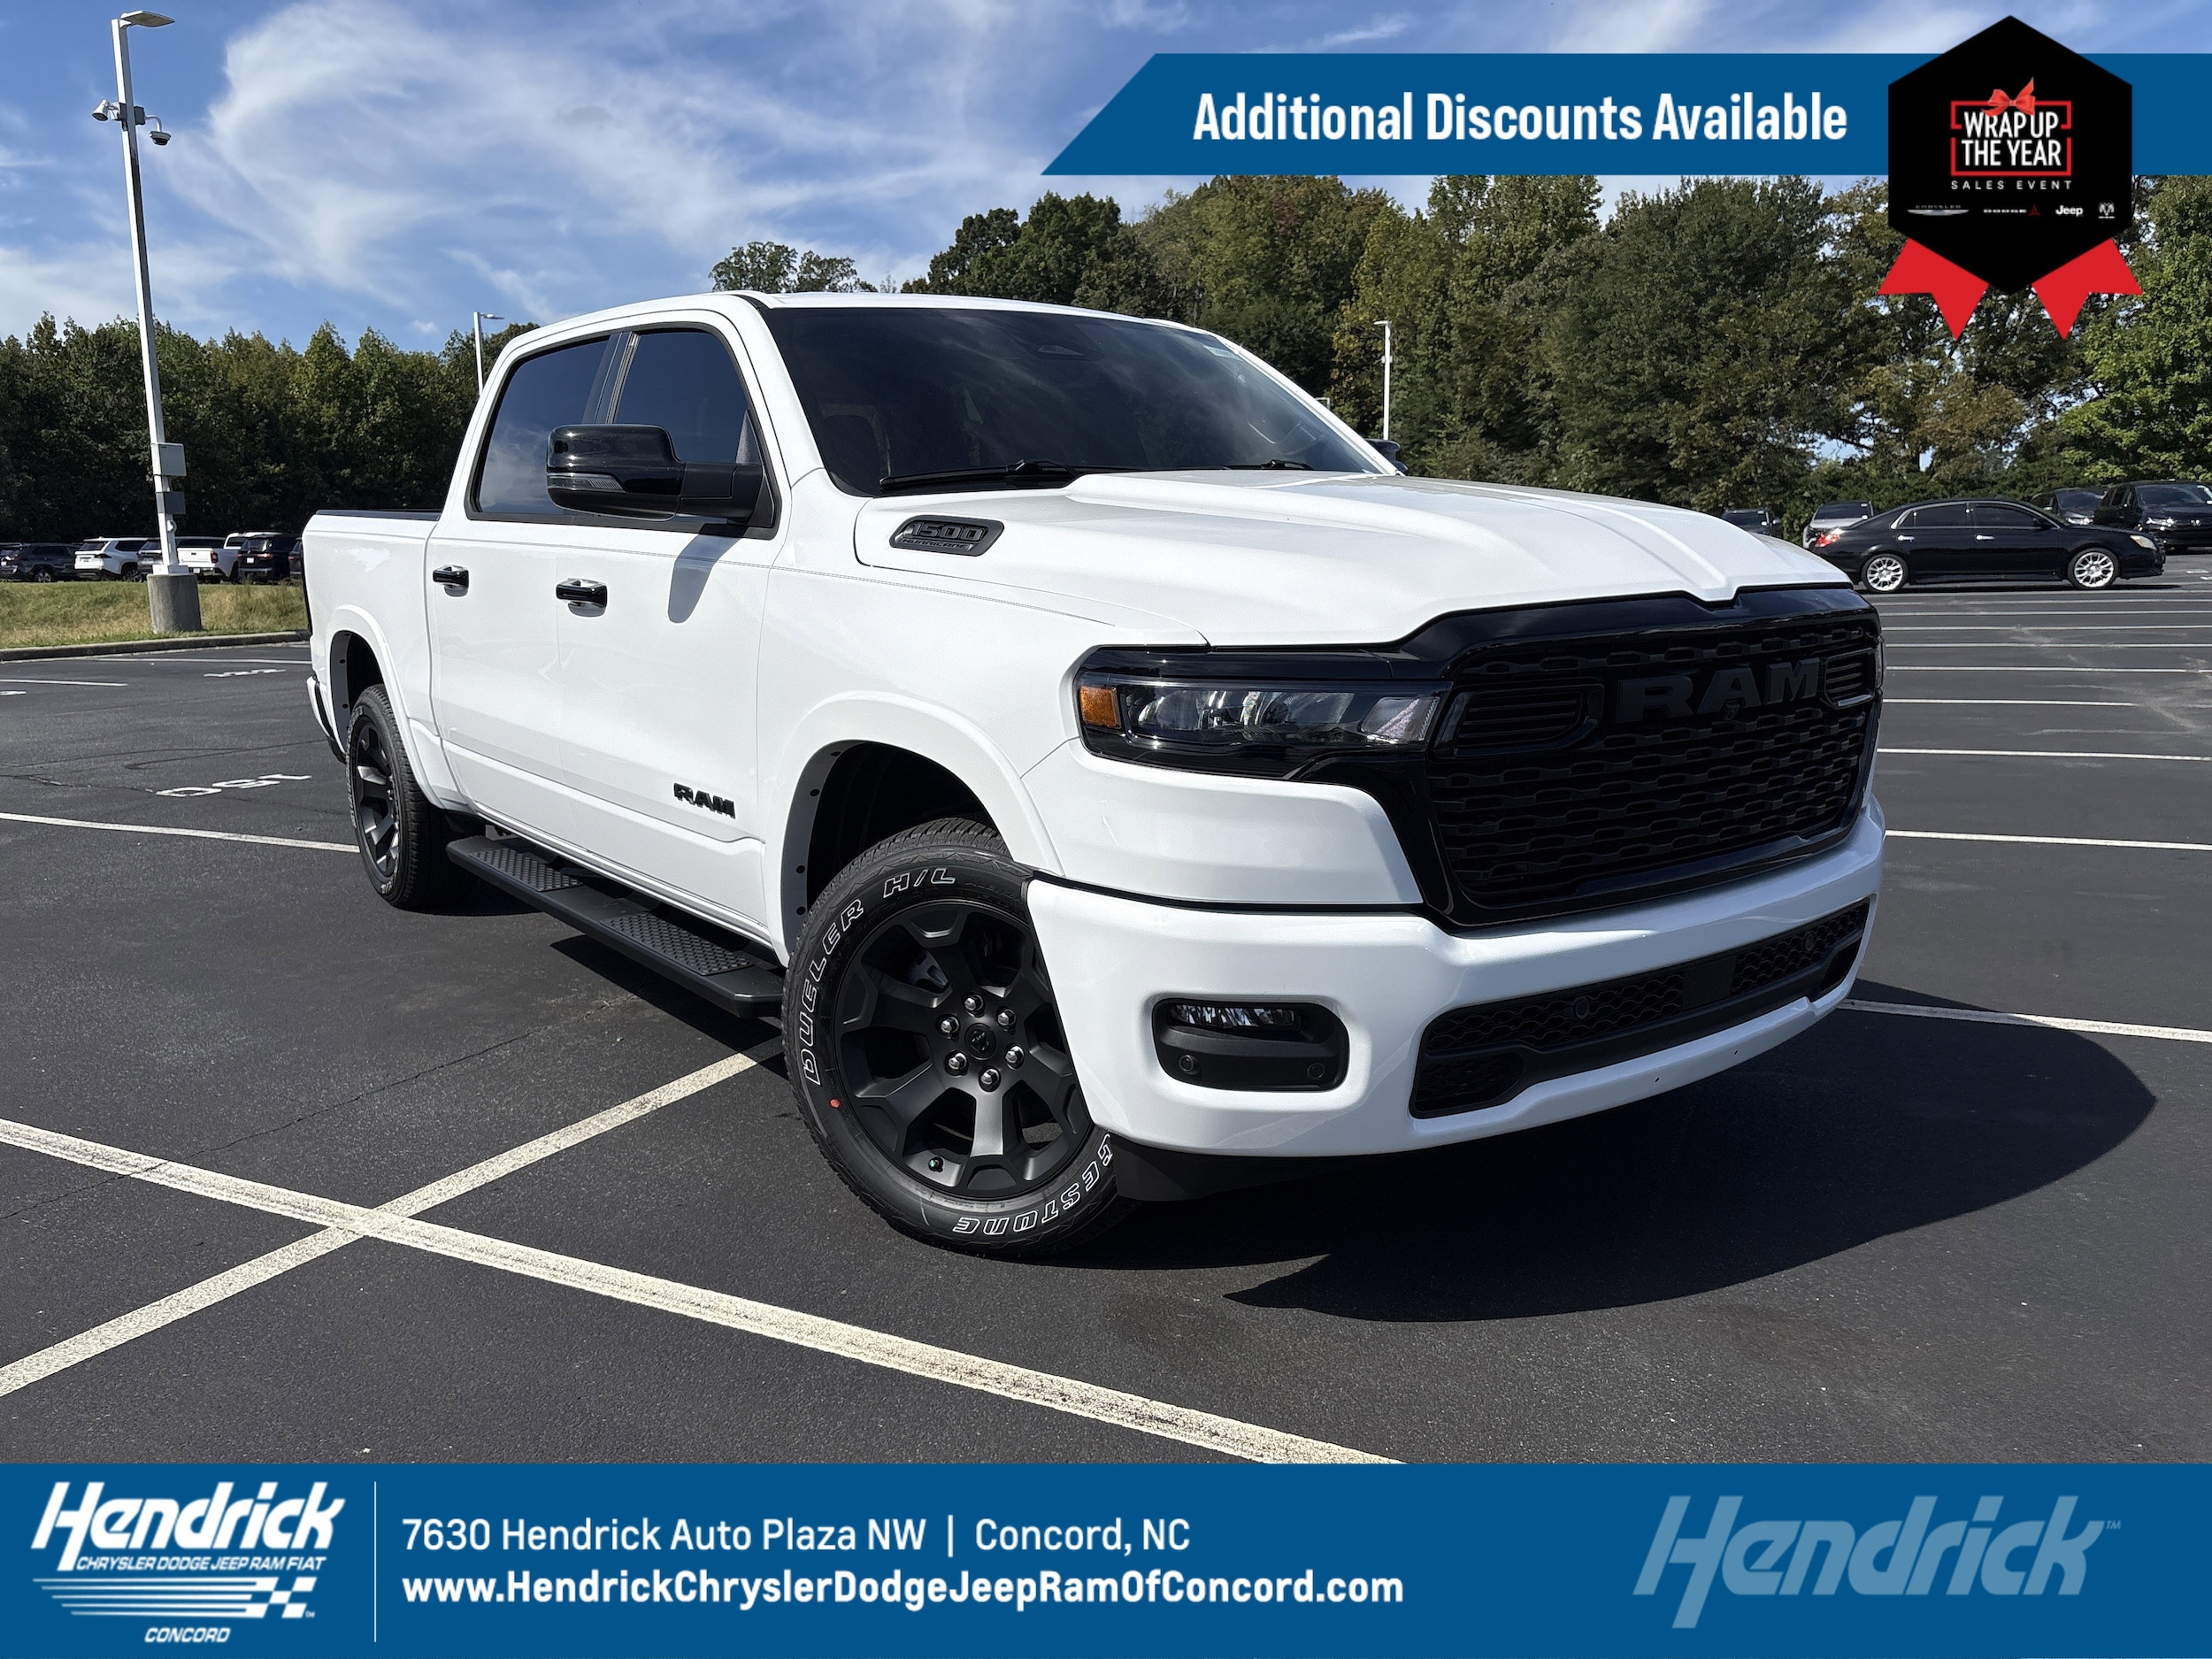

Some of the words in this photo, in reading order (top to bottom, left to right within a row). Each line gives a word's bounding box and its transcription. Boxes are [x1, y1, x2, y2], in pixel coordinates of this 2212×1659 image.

[902, 538, 969, 549] HURRICANE
[906, 521, 985, 541] 1500
[1616, 657, 1821, 724] RAM
[673, 782, 736, 819] RAM
[798, 898, 865, 1087] DUELER
